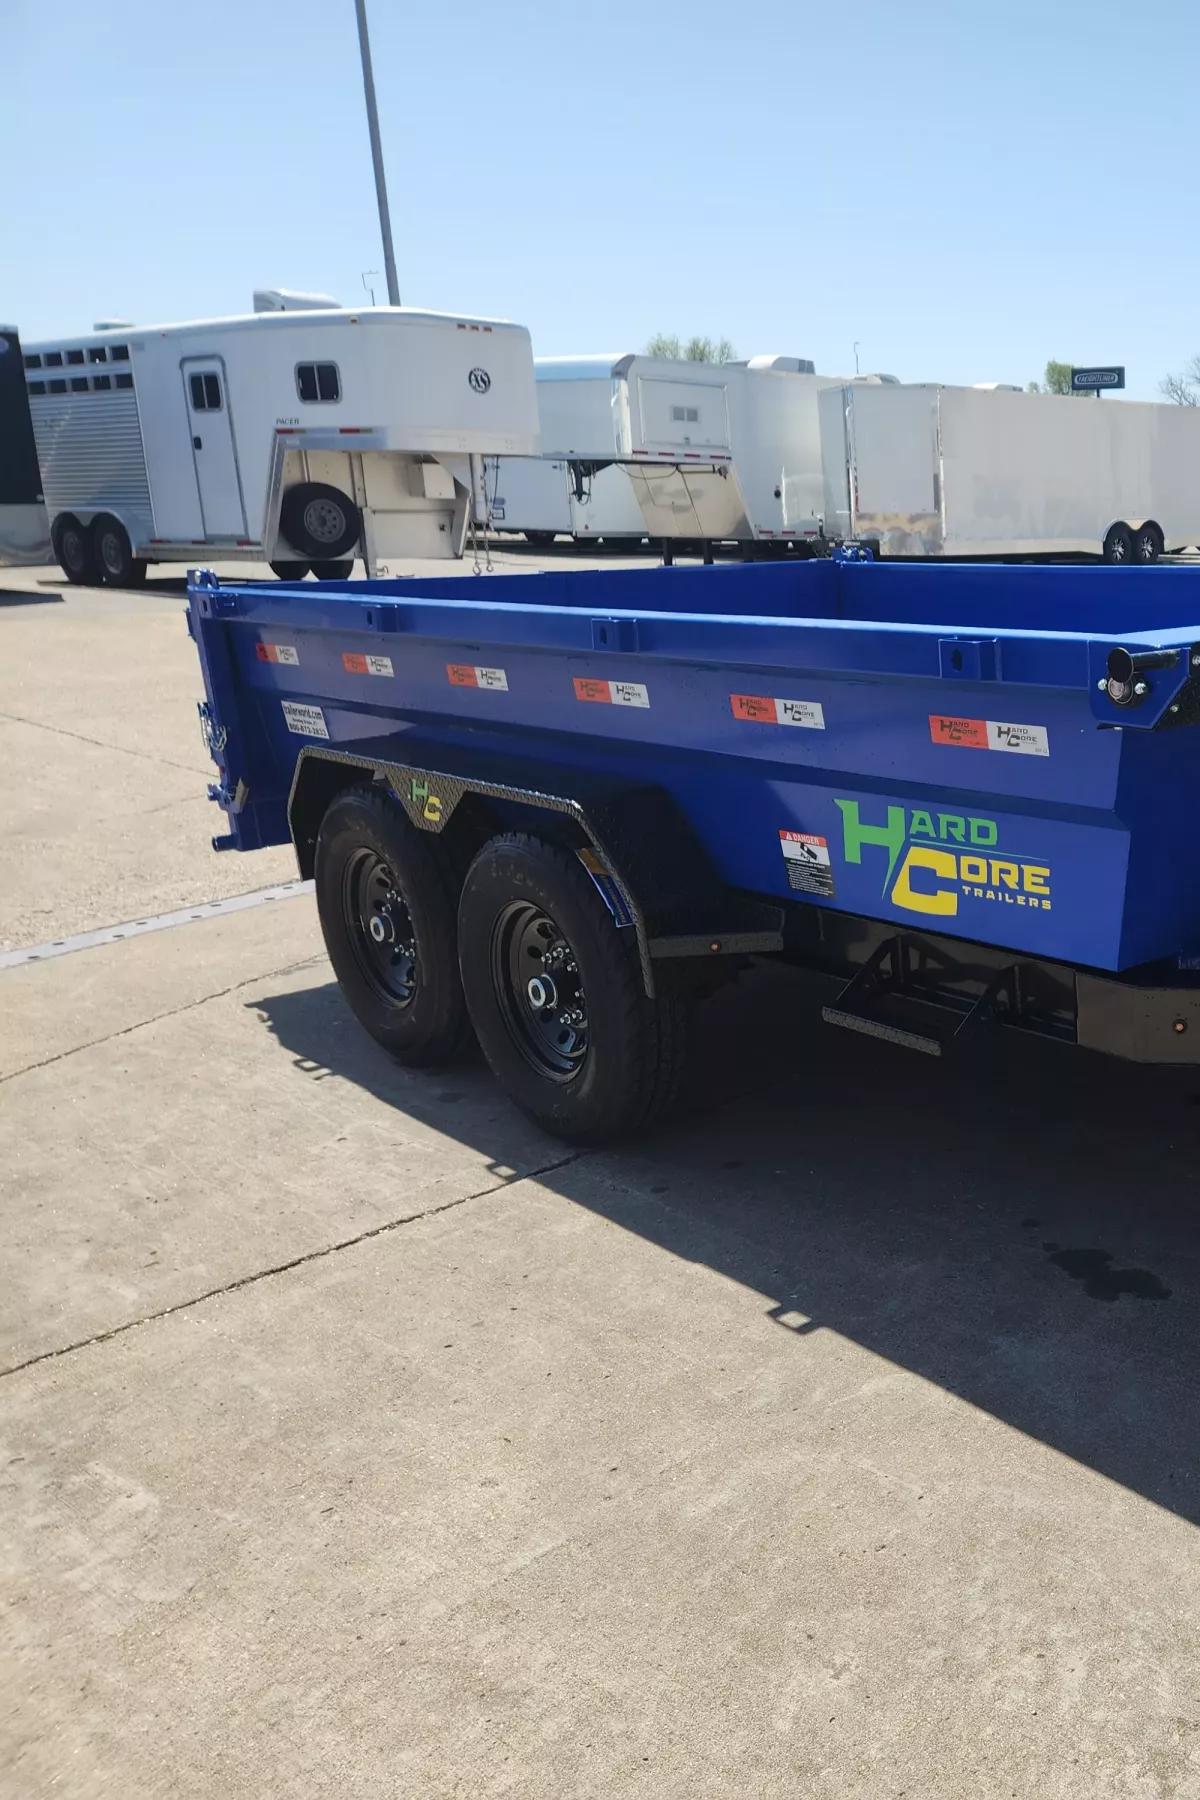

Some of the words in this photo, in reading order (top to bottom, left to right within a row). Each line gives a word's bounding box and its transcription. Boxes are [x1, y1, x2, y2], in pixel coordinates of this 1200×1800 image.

[792, 833, 820, 844] DANGER
[833, 798, 998, 900] HARD
[891, 845, 1051, 916] CORE
[962, 885, 1052, 910] TRAILERS
